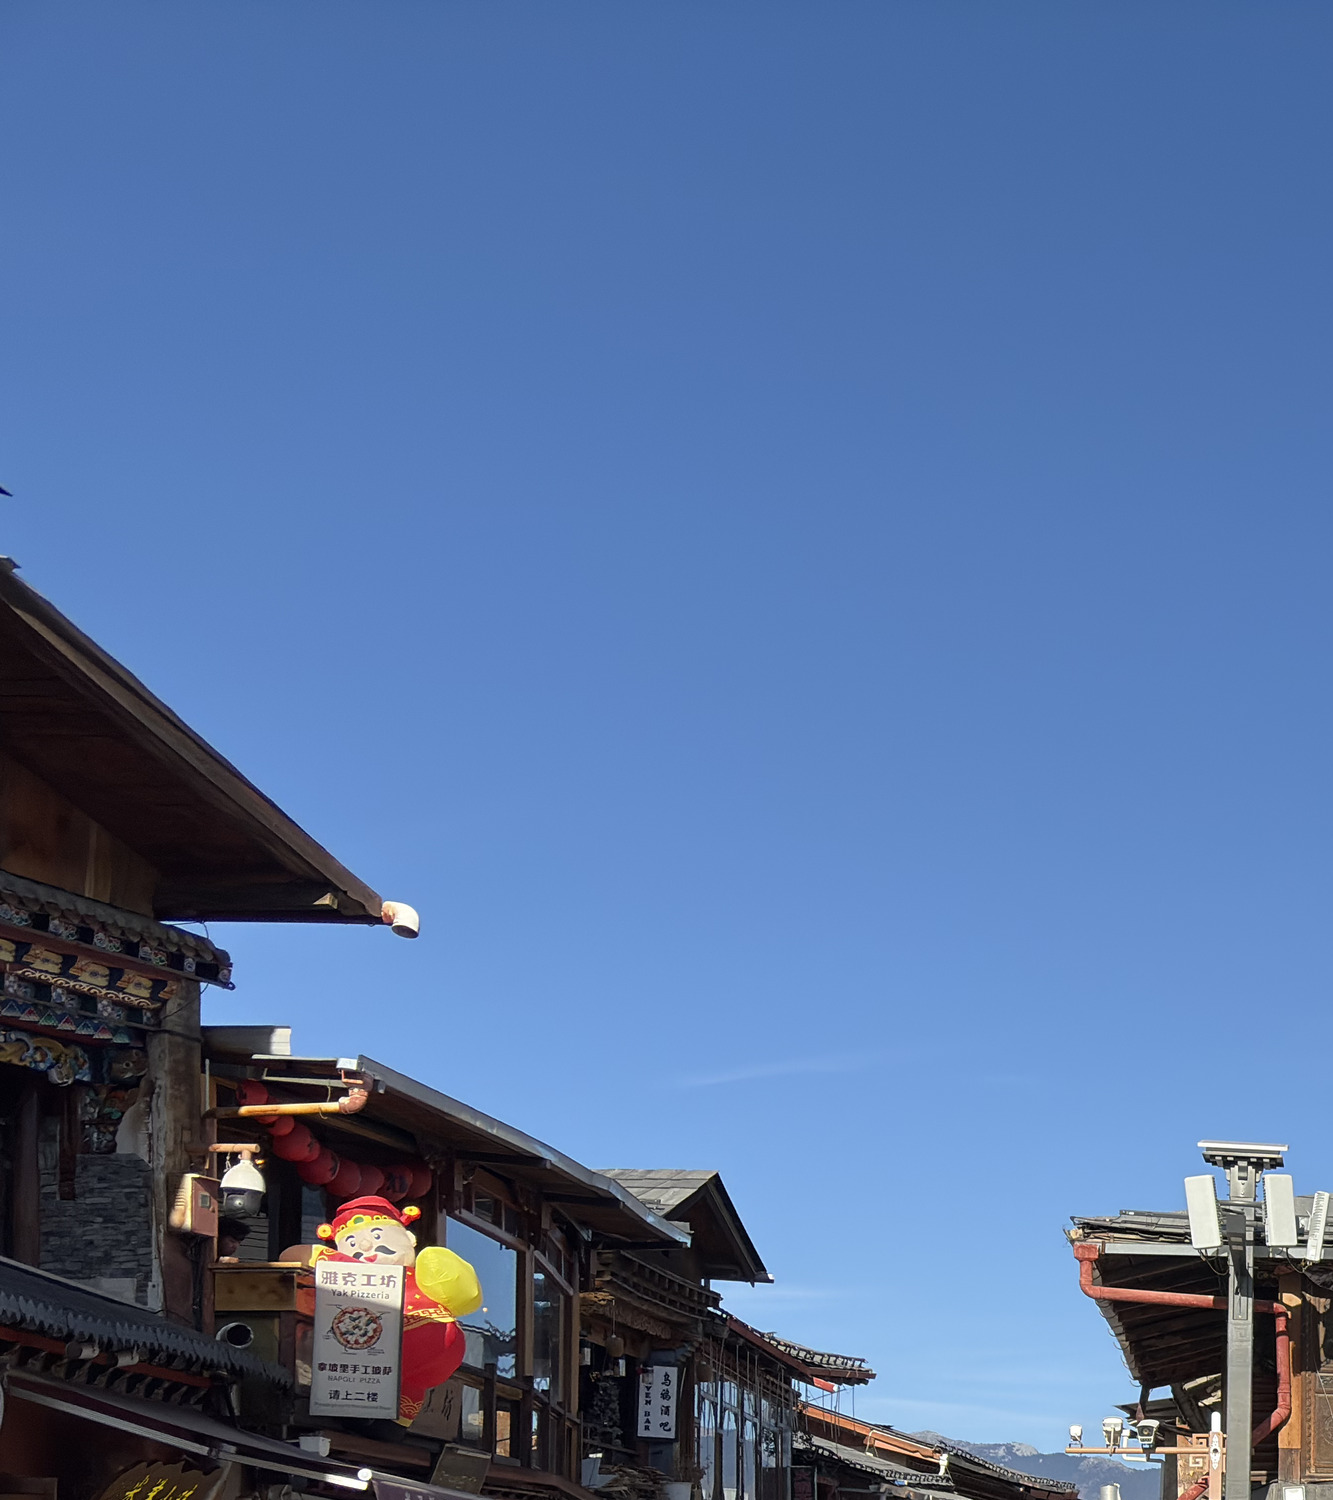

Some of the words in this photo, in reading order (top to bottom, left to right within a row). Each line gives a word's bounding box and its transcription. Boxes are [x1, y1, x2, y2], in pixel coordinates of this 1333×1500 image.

[321, 1270, 397, 1289] 雅克工坊
[331, 1289, 349, 1297] Yak
[350, 1289, 390, 1300] Pizzeria
[327, 1375, 356, 1383] NAPOLI
[359, 1376, 381, 1385] PIZZA
[328, 1389, 379, 1403] 请上二楼
